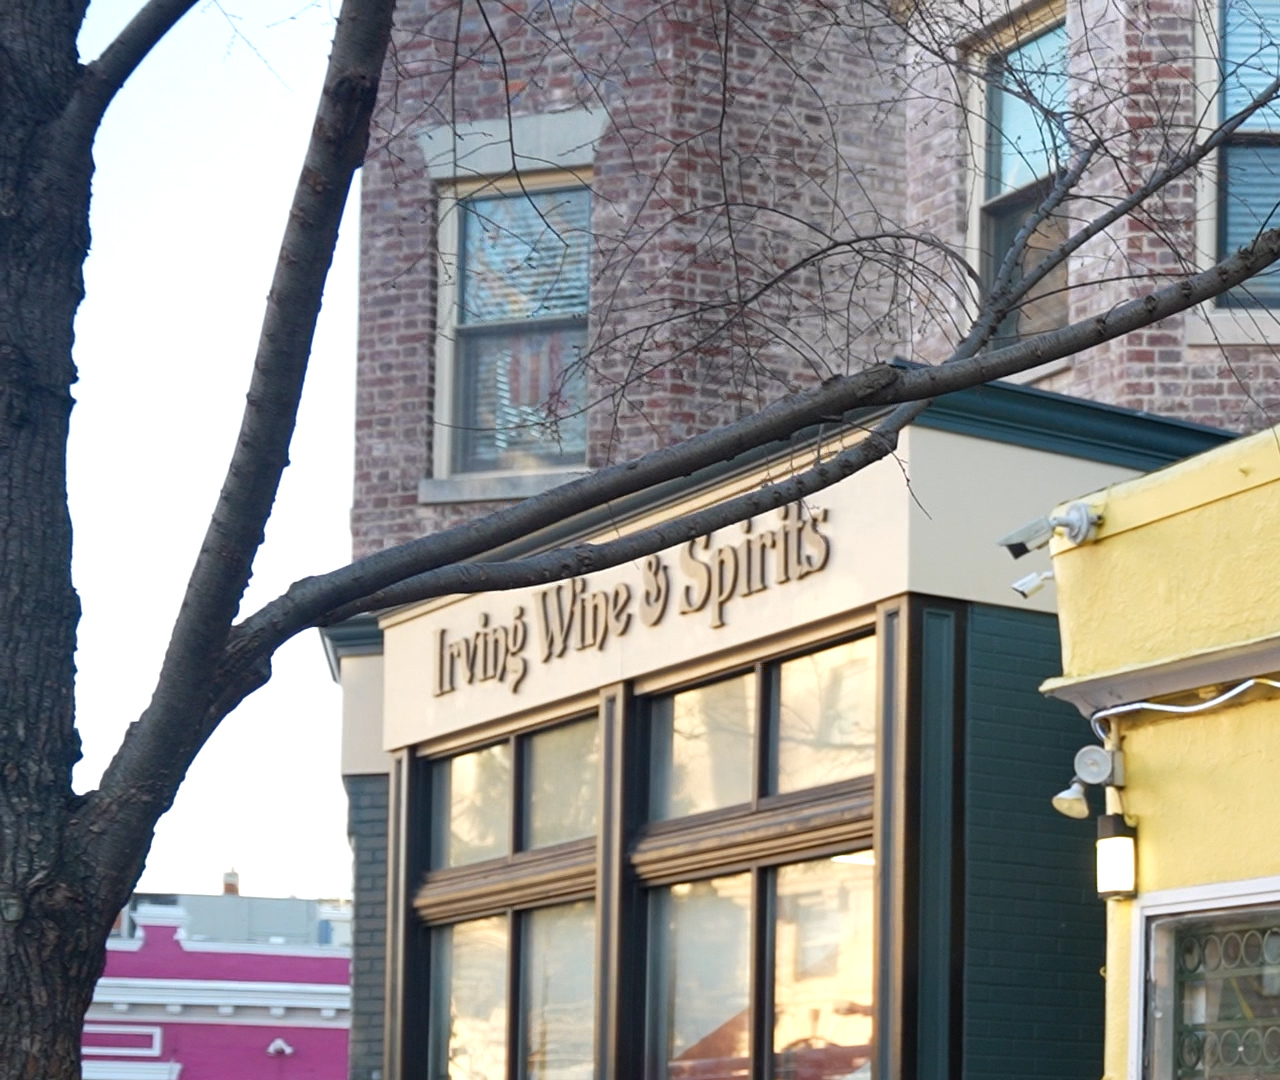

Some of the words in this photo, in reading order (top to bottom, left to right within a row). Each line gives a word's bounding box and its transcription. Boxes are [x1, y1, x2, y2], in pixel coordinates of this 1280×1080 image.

[433, 606, 528, 697] Irving
[532, 578, 634, 662] Wine
[640, 554, 670, 627] &
[680, 503, 831, 628] Spirits
